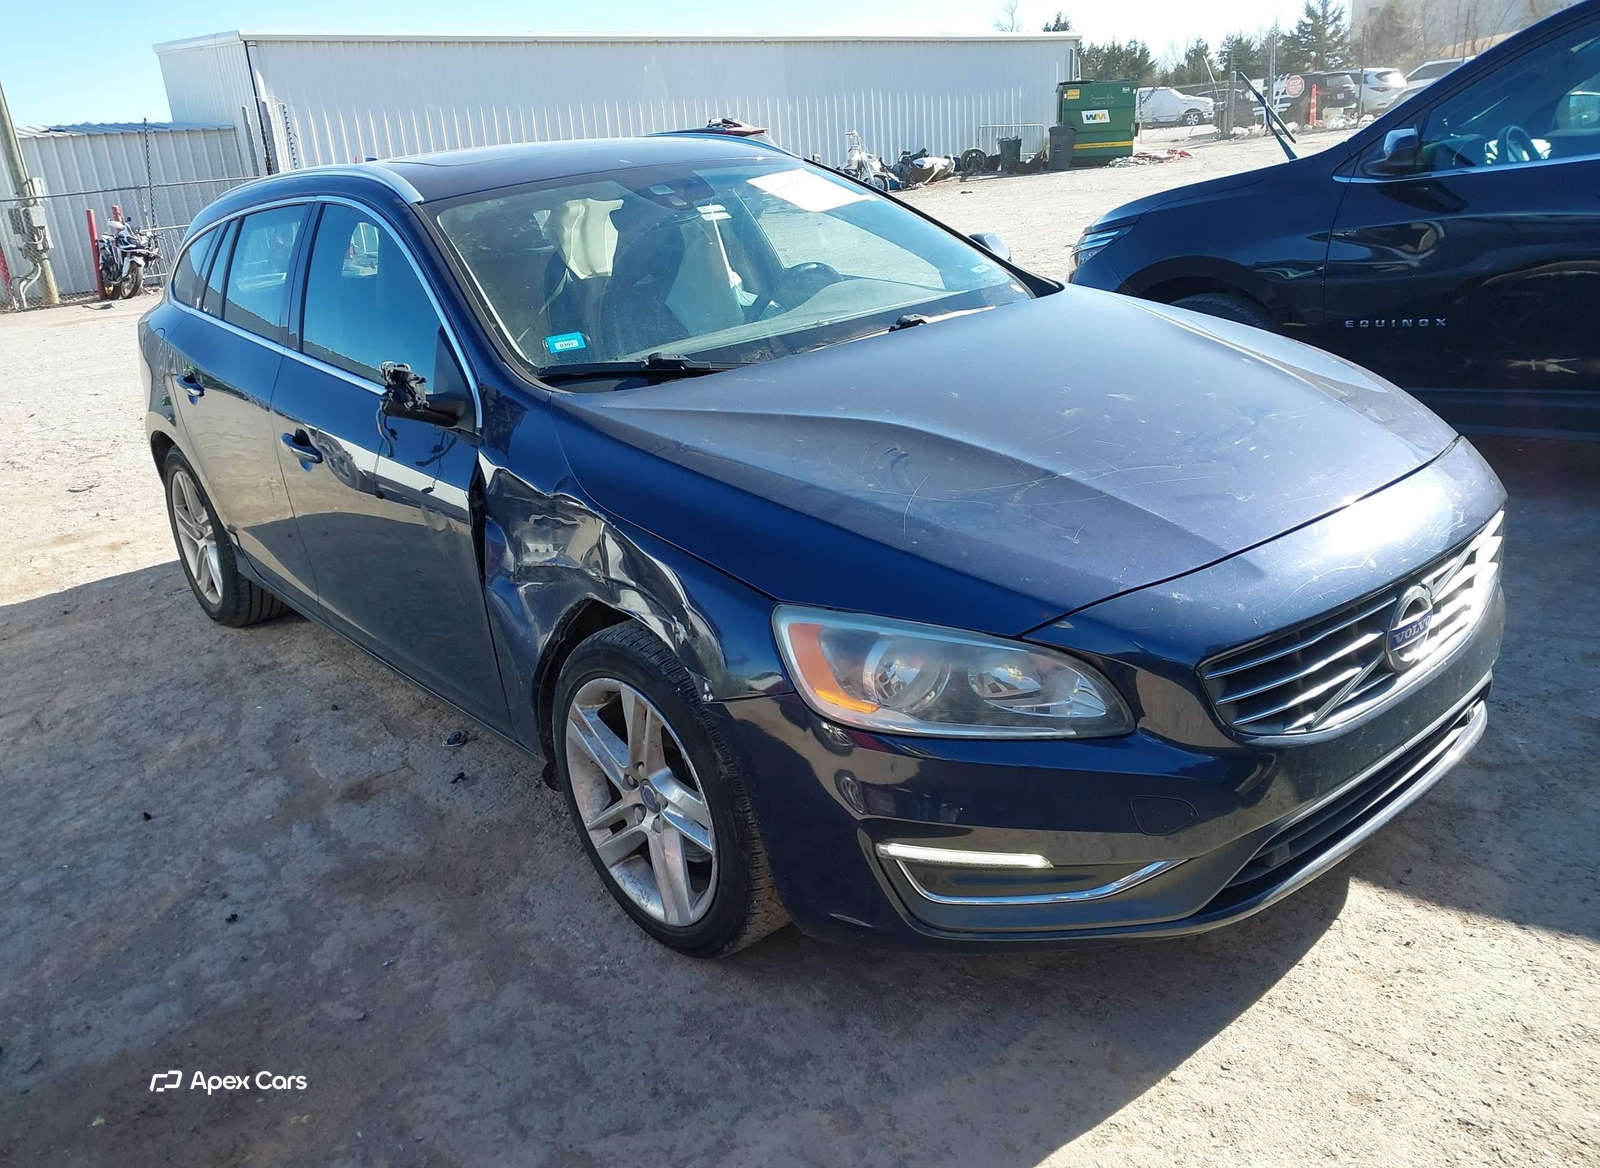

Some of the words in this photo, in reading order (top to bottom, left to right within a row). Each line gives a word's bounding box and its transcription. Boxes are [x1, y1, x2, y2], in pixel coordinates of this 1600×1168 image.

[1086, 113, 1106, 121] WM
[1345, 318, 1446, 328] EQUINOX
[548, 334, 581, 343] PARKING
[1393, 615, 1431, 643] VOLVO
